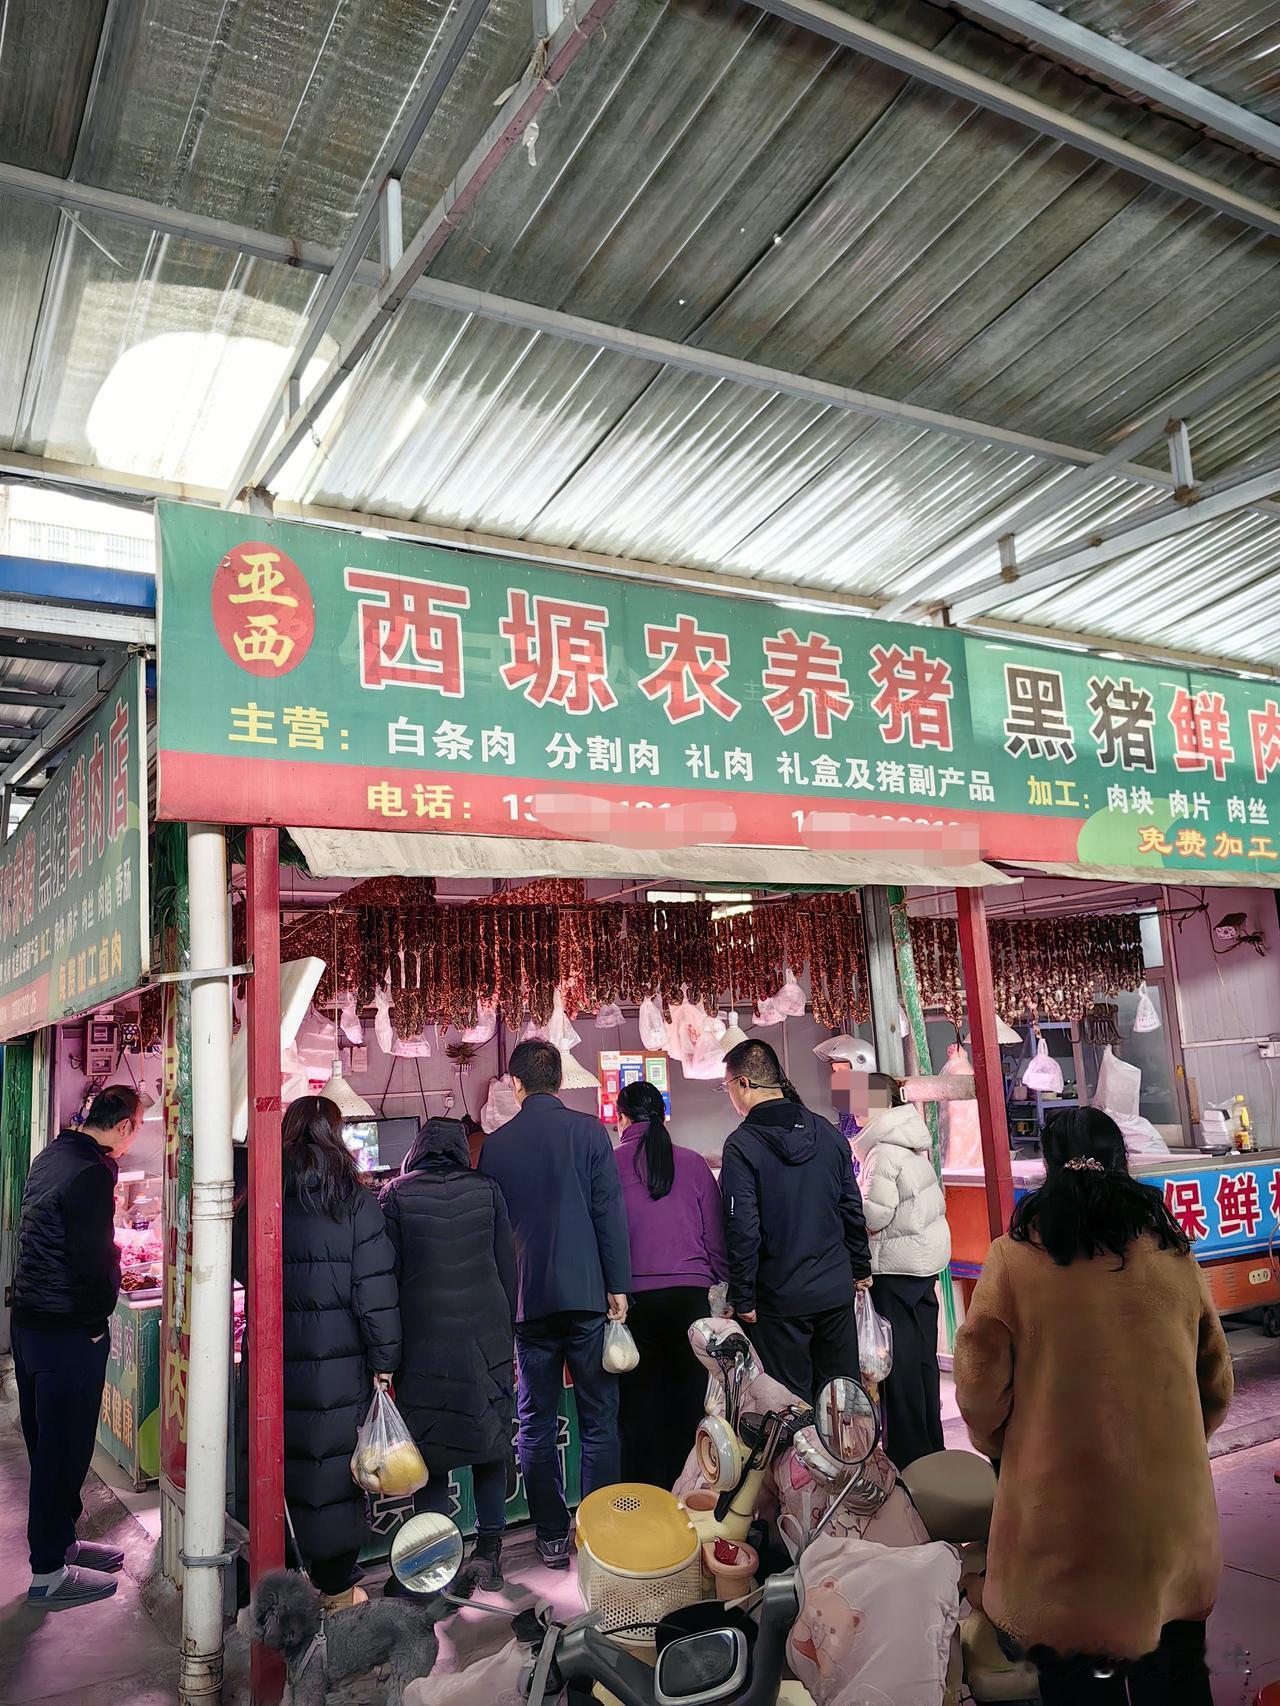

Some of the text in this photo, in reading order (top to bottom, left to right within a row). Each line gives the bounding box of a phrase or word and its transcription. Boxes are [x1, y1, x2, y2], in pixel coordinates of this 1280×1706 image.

[228, 552, 299, 667] 亚西
[343, 567, 955, 751] 西塬农养猪
[38, 697, 129, 914] 黑猪鲜肉店
[387, 716, 517, 765] 白条肉
[545, 732, 660, 775] 分割肉
[685, 743, 755, 783] 礼肉
[776, 750, 995, 803] 礼盒及猪副产品
[1107, 783, 1154, 815] 肉块
[1168, 789, 1211, 821] 肉片
[1227, 795, 1270, 825] 肉丝
[1138, 825, 1278, 859] 免费加工
